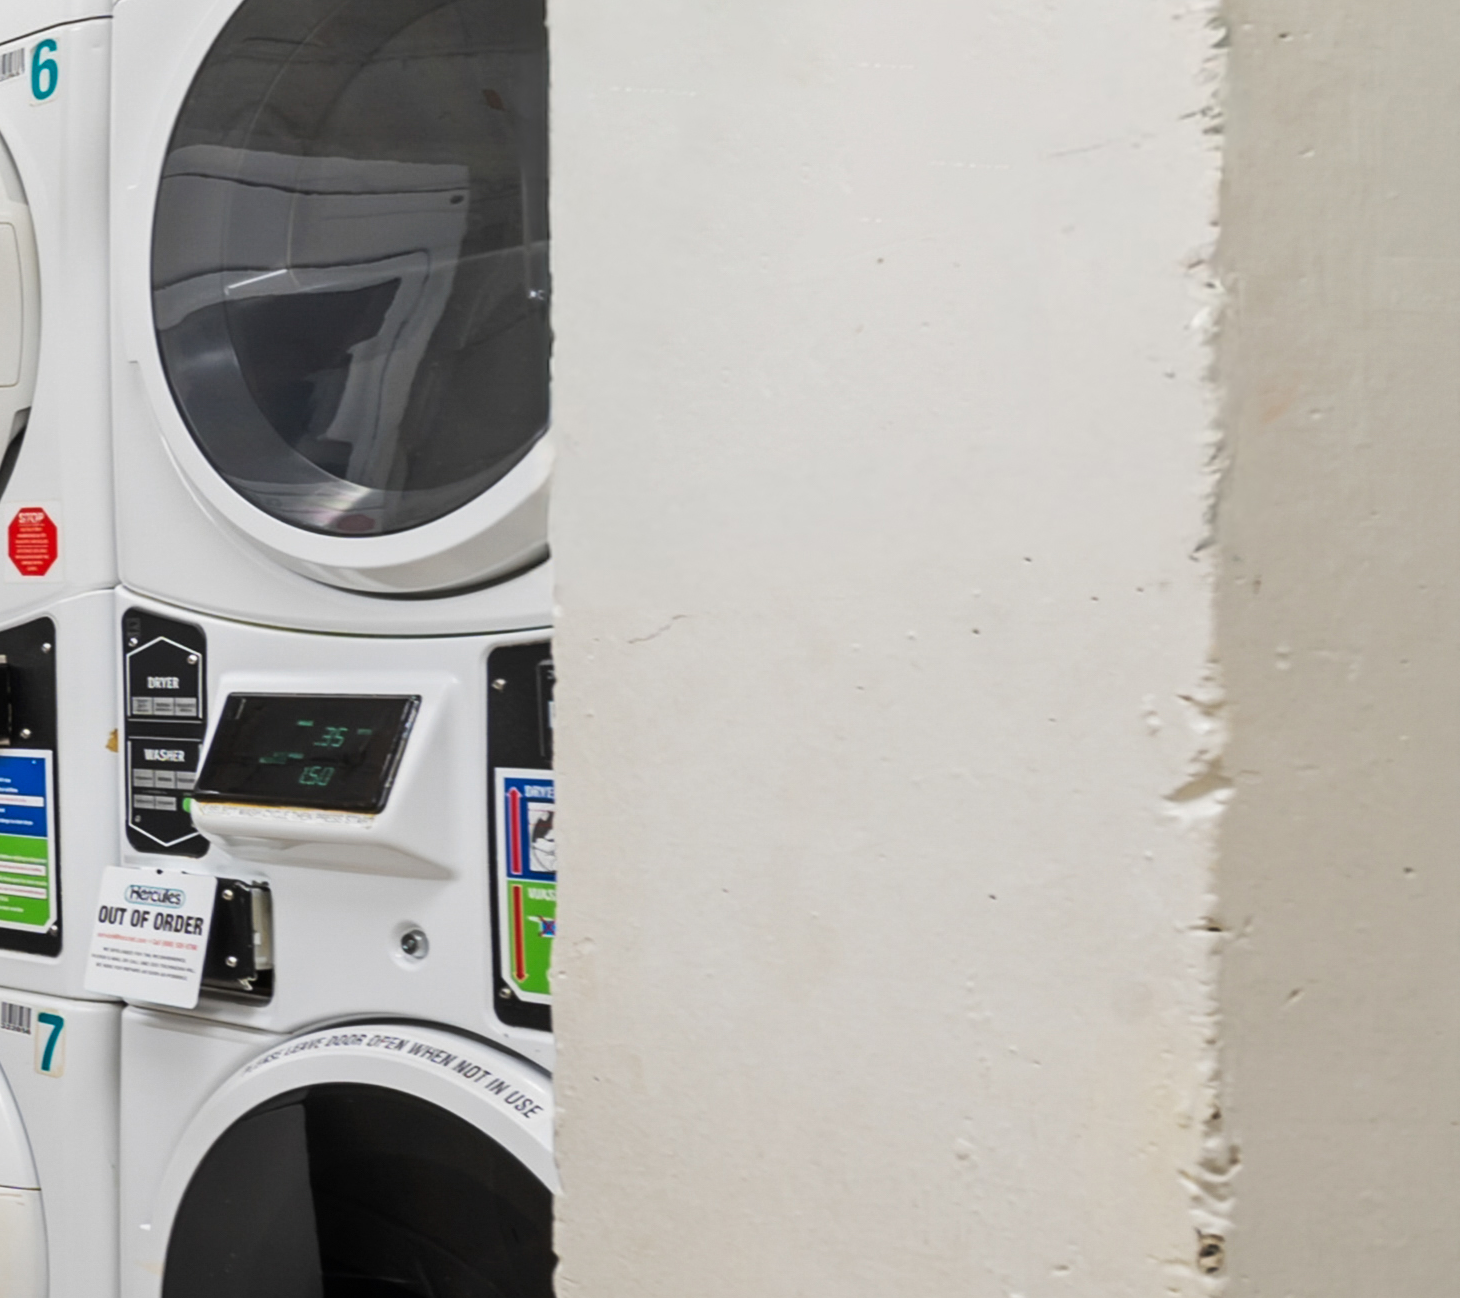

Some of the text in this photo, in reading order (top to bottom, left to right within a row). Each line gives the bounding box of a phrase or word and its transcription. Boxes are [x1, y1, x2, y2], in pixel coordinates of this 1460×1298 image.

[31, 38, 59, 101] 6
[146, 676, 180, 689] DRYER
[144, 748, 186, 762] WASHER
[130, 885, 181, 905] Hercules
[98, 905, 204, 936] OUT OF ORDER
[37, 1012, 65, 1072] 7
[325, 1034, 366, 1048] DOOR
[367, 1034, 407, 1051] OPEN
[407, 1042, 455, 1068] WHEN
[452, 1057, 492, 1083] NOT
[485, 1074, 510, 1095] IN
[503, 1088, 544, 1119] USE
